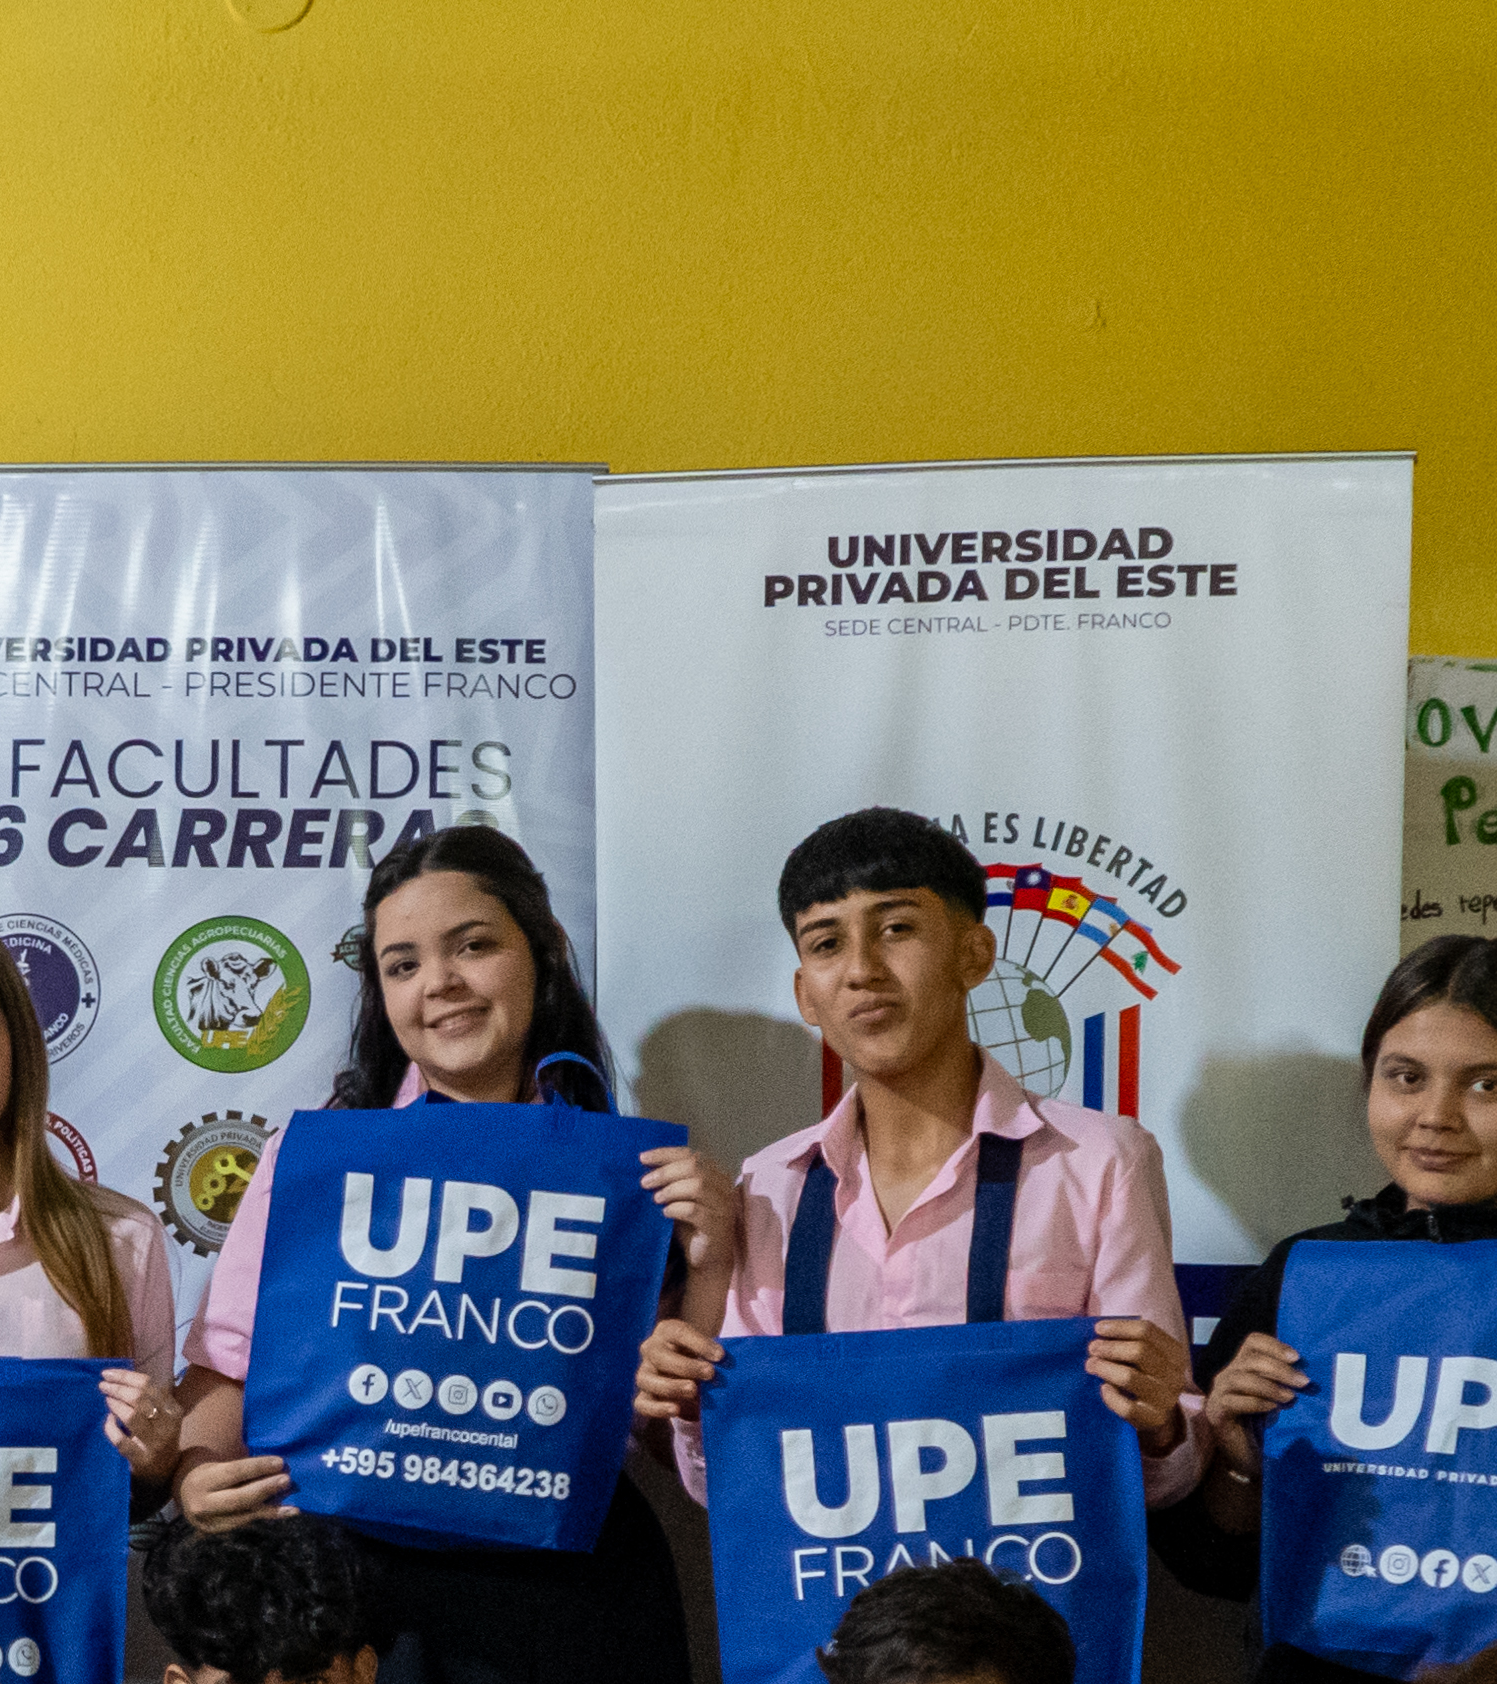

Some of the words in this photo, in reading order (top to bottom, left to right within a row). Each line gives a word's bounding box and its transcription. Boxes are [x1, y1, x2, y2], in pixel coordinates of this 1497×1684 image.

[827, 527, 1173, 570] UNIVERSIDAD
[764, 567, 988, 607] PRIVADA
[1006, 566, 1100, 600] DEL
[1116, 564, 1238, 598] ESTE
[825, 617, 881, 637] SEDE
[887, 615, 988, 635] CENTRAL
[1010, 614, 1070, 631] PDTE.
[1077, 612, 1171, 631] FRANCO
[186, 637, 357, 664] PRIVADA
[371, 638, 443, 664] DEL
[455, 638, 547, 665] ESTE
[186, 672, 411, 699] PRESIDENTE
[425, 672, 577, 700] FRANCO
[11, 739, 511, 800] FACULTADES
[984, 812, 1019, 844] ES
[1033, 816, 1187, 918] LIBERTAD
[7, 919, 62, 939] CIENCIAS
[191, 925, 287, 959] AGROPECUARIAS
[163, 943, 192, 996] CIENCIAS
[163, 1000, 201, 1054] FACULTAD
[175, 1135, 218, 1187] UNIVERSIDAD
[340, 1172, 605, 1298] UPE
[330, 1281, 594, 1354] FRANCO
[321, 1446, 396, 1481] +595
[403, 1454, 571, 1500] 984364238
[782, 1411, 1074, 1539] UPE
[1323, 1462, 1429, 1479] UNIVERSIDAD
